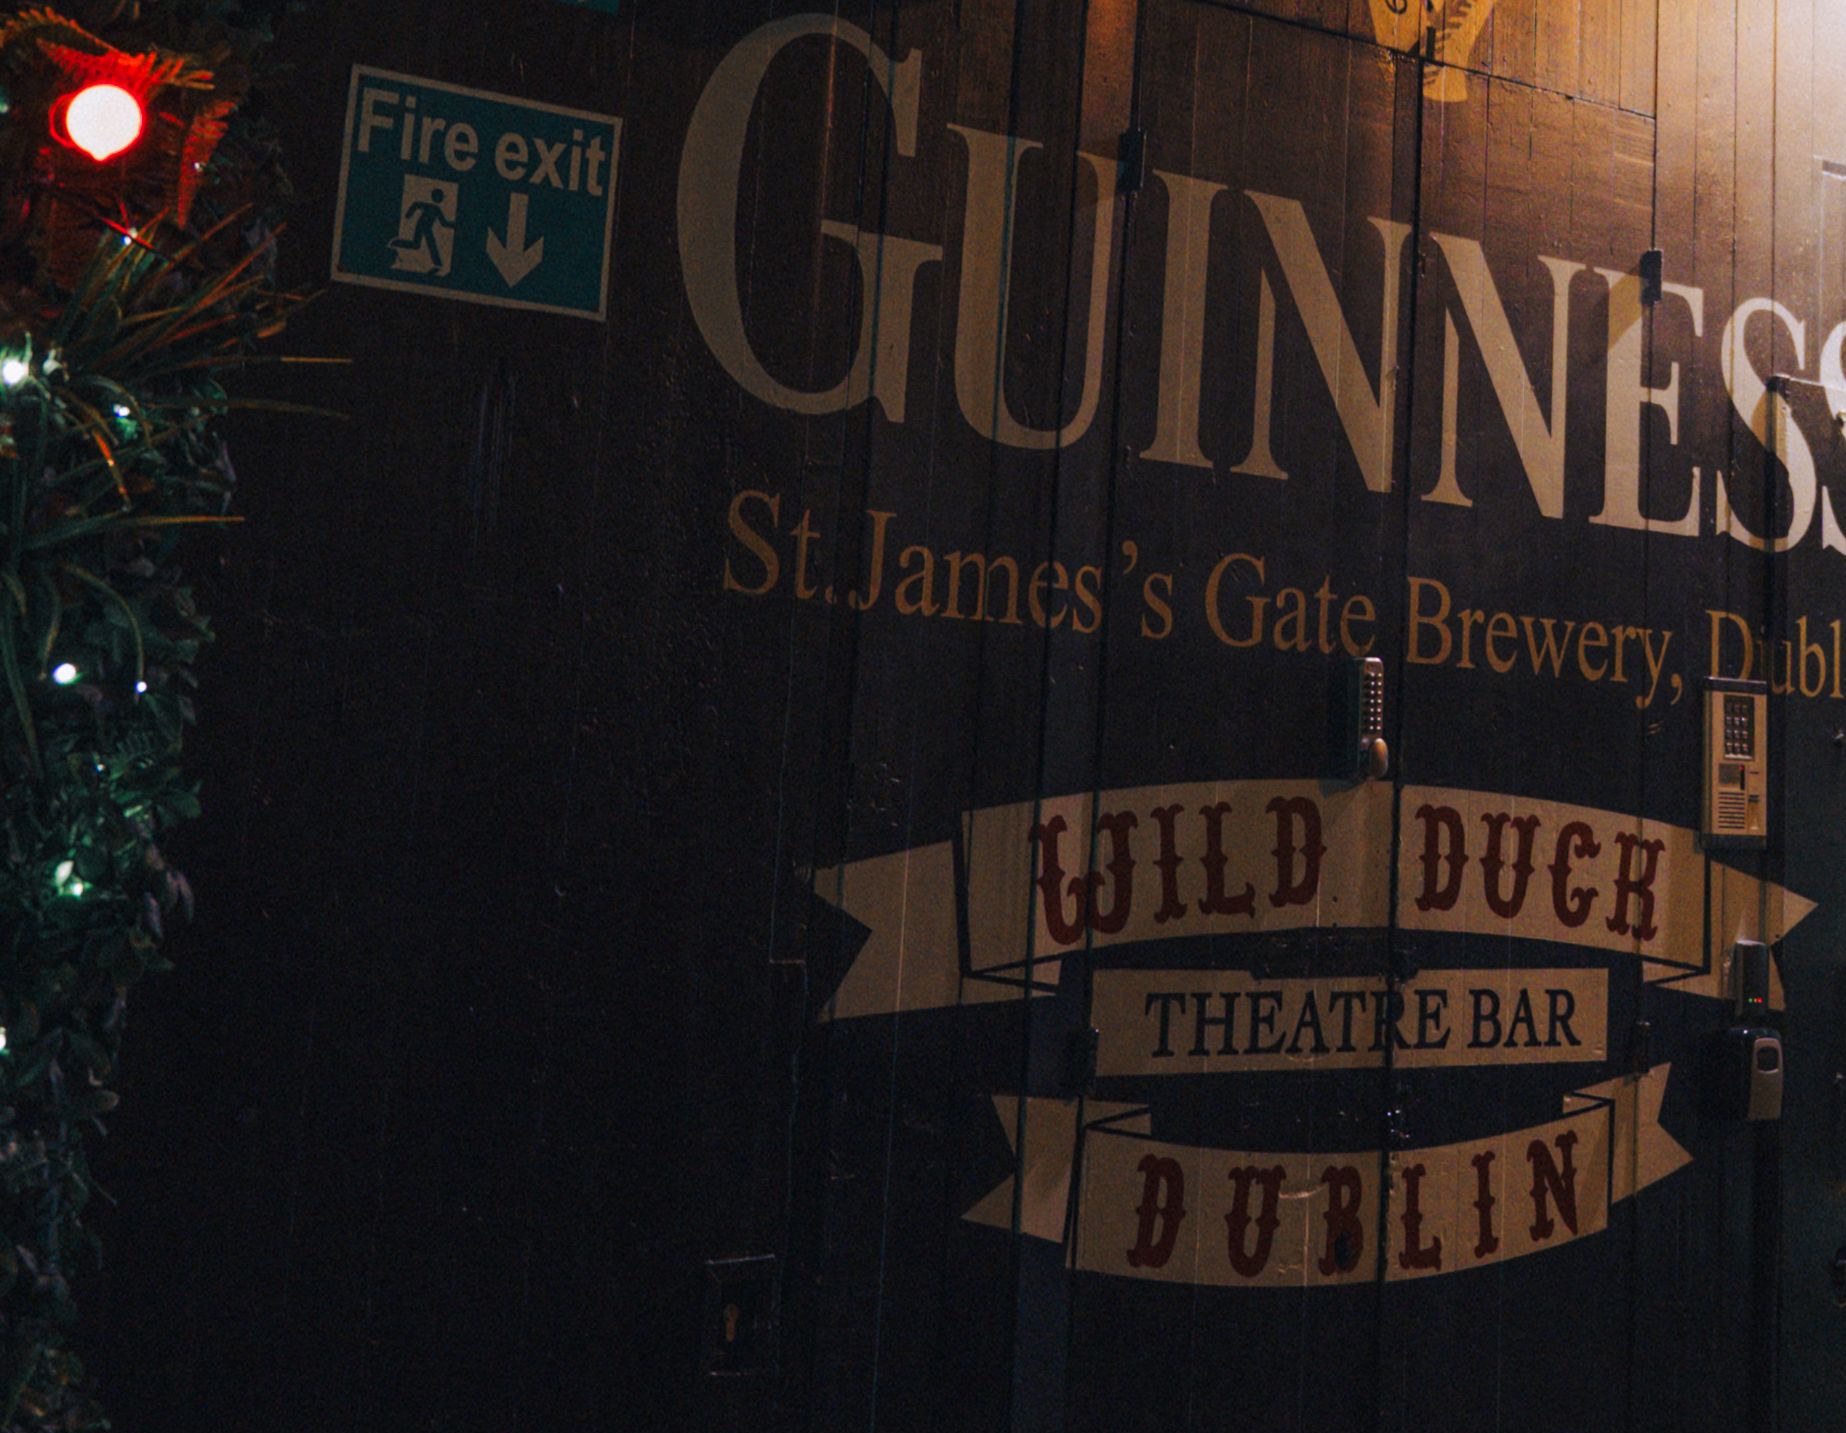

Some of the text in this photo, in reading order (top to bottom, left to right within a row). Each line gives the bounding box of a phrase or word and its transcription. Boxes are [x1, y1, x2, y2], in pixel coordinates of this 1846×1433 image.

[357, 87, 607, 197] Fire exit
[1205, 553, 1377, 659] Gate
[1404, 576, 1682, 709] Brewery,
[1029, 795, 1666, 944] WILD DUCK
[1145, 988, 1582, 1057] THEATRE BAR
[1125, 1130, 1580, 1279] DUBLIN
